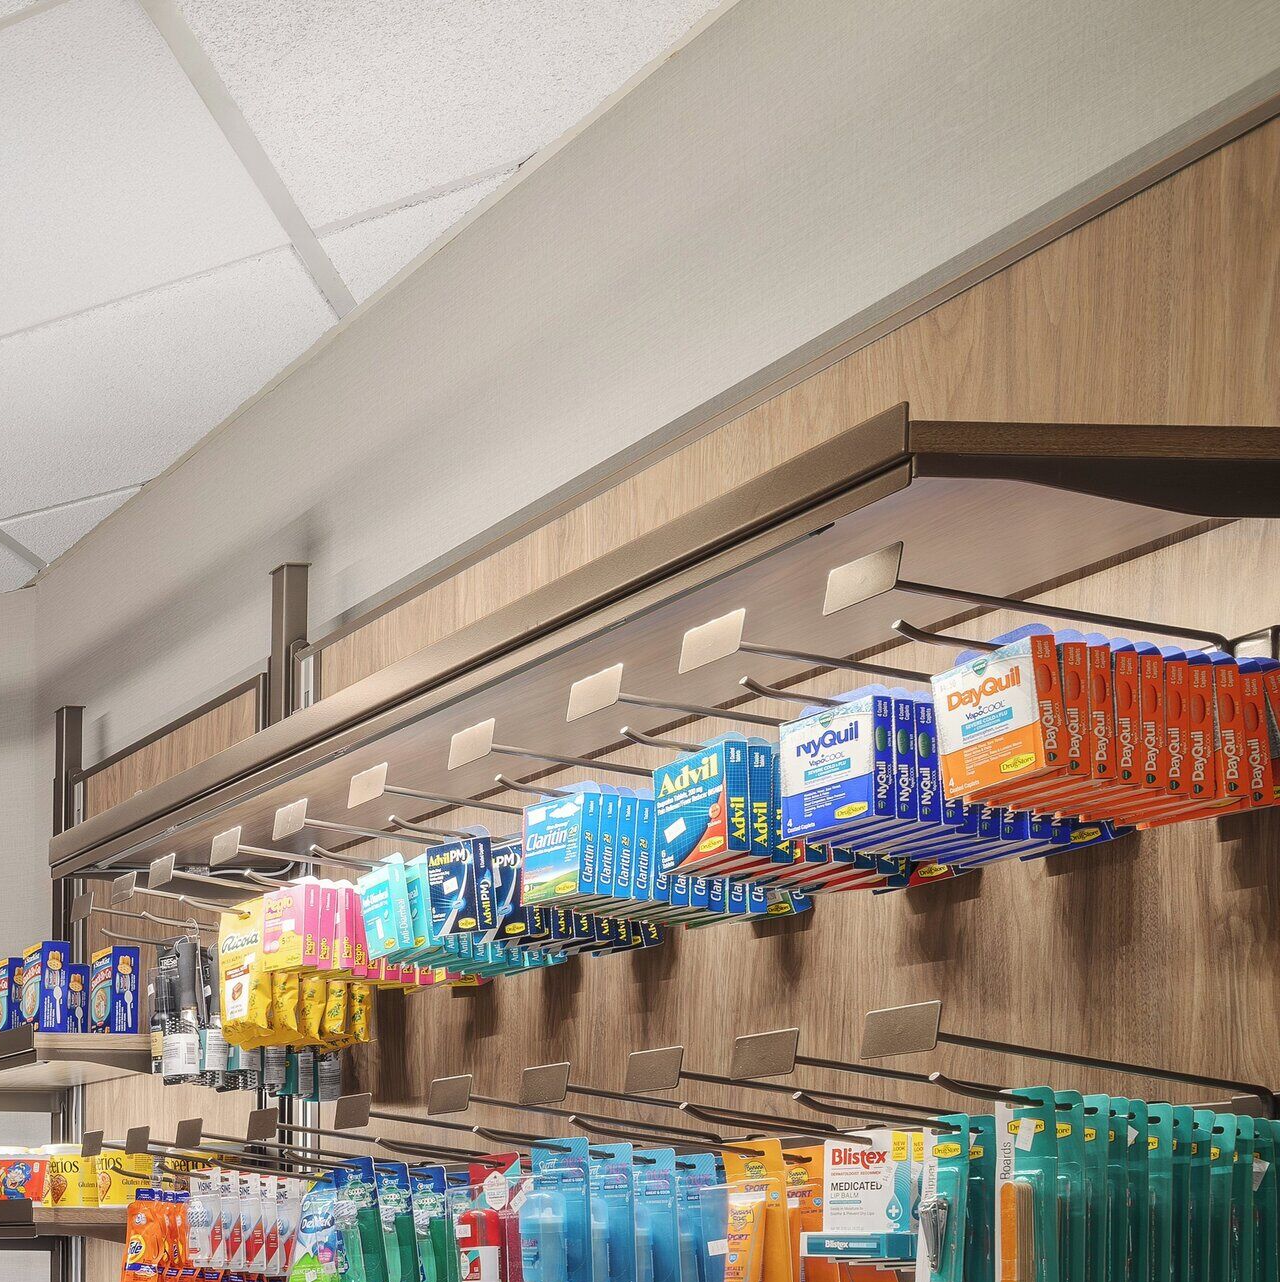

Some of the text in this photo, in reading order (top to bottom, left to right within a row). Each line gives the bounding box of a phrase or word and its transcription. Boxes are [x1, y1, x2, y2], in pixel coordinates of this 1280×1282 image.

[947, 666, 1021, 712] DayQuil
[964, 701, 1005, 721] VapoCOOL
[1000, 755, 1035, 772] DrugStore
[1169, 727, 1180, 778] DayQuil
[1192, 730, 1204, 782] DayQuil
[1226, 729, 1240, 780] DayQuil
[1251, 738, 1264, 790] DayQuil
[656, 752, 720, 800] Advil
[876, 760, 888, 800] NyQuil
[898, 764, 910, 802] NyQuil
[922, 767, 932, 806] NyQuil
[732, 796, 745, 842] Advil
[753, 802, 768, 847] Advil
[836, 804, 866, 817] DrugStore
[526, 831, 567, 852] Claritin
[619, 847, 629, 887] Claritin
[637, 849, 648, 890] Claritin
[221, 931, 259, 954] Ricola
[831, 1148, 888, 1170] Blistex
[933, 1144, 960, 1157] DrugStore
[1000, 1140, 1012, 1181] Boards
[198, 1181, 212, 1191] VISINE
[745, 1184, 770, 1192] SPORT
[790, 1190, 813, 1198] SPORT
[831, 1182, 882, 1191] MEDICATED
[728, 1233, 751, 1241] SPORT
[825, 1240, 849, 1250] Blistex
